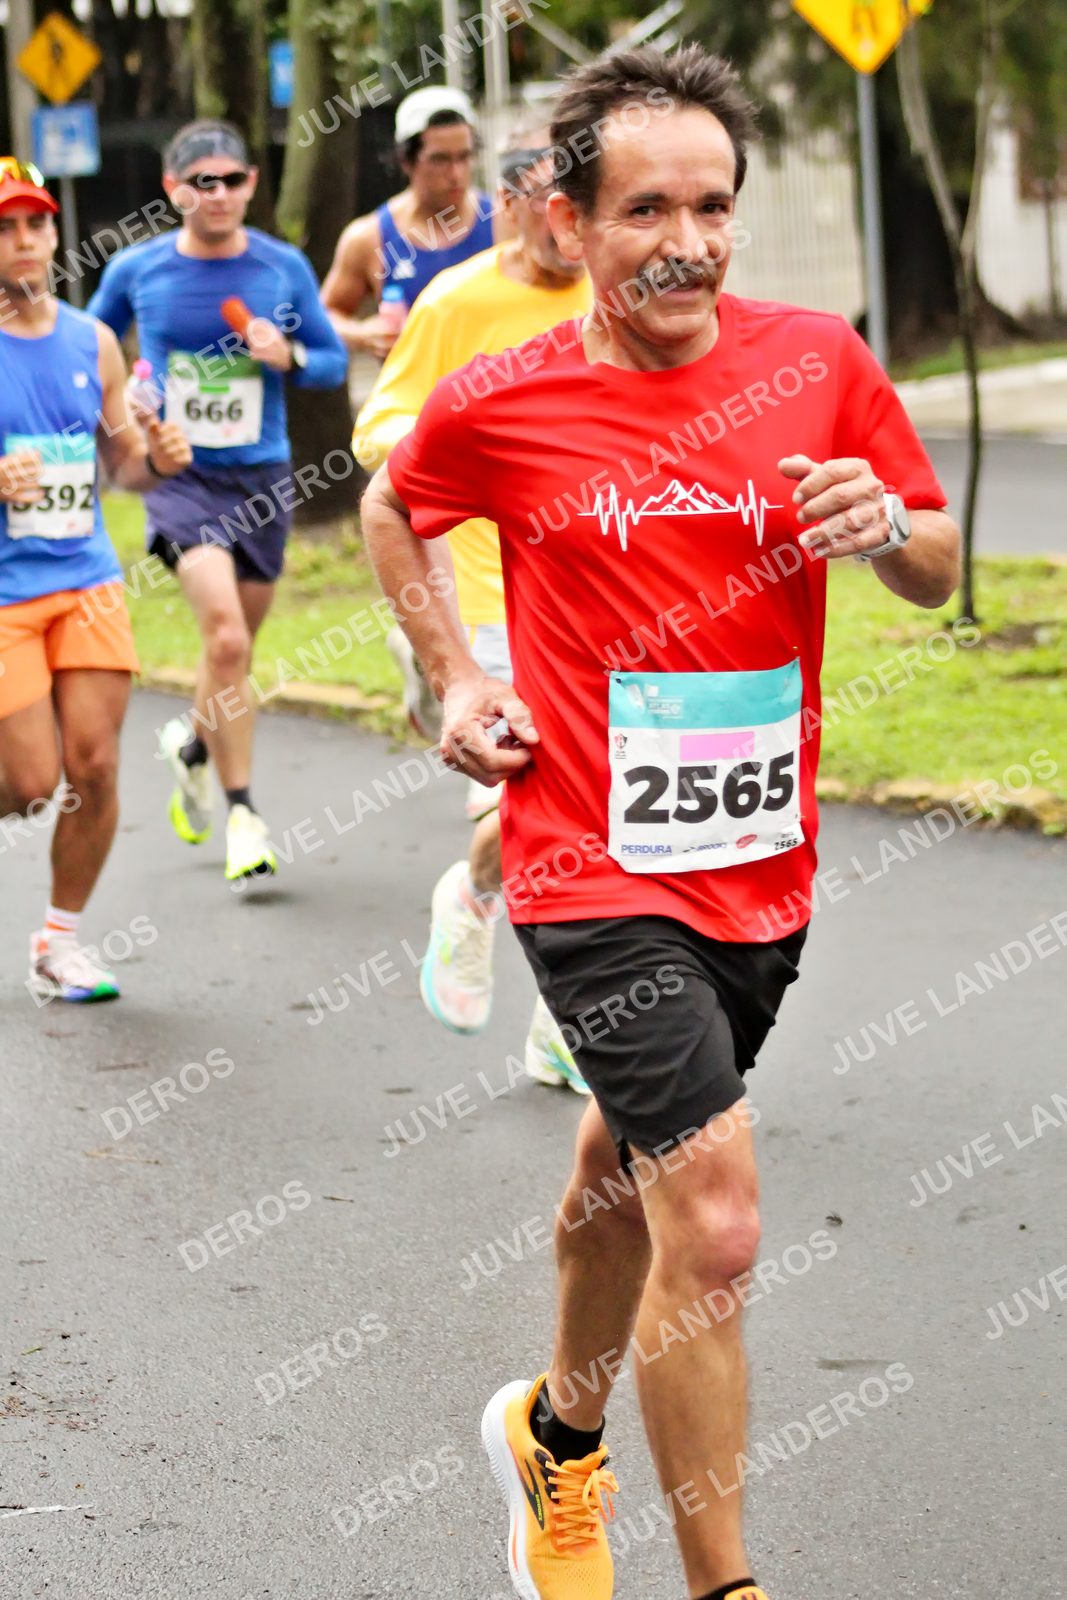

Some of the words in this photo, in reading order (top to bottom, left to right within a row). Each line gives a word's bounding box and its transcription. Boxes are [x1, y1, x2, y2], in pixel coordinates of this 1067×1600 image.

[185, 398, 243, 423] 666
[12, 483, 93, 512] 392
[623, 751, 794, 824] 2565
[621, 844, 672, 854] PERDURA
[774, 838, 798, 851] 2565
